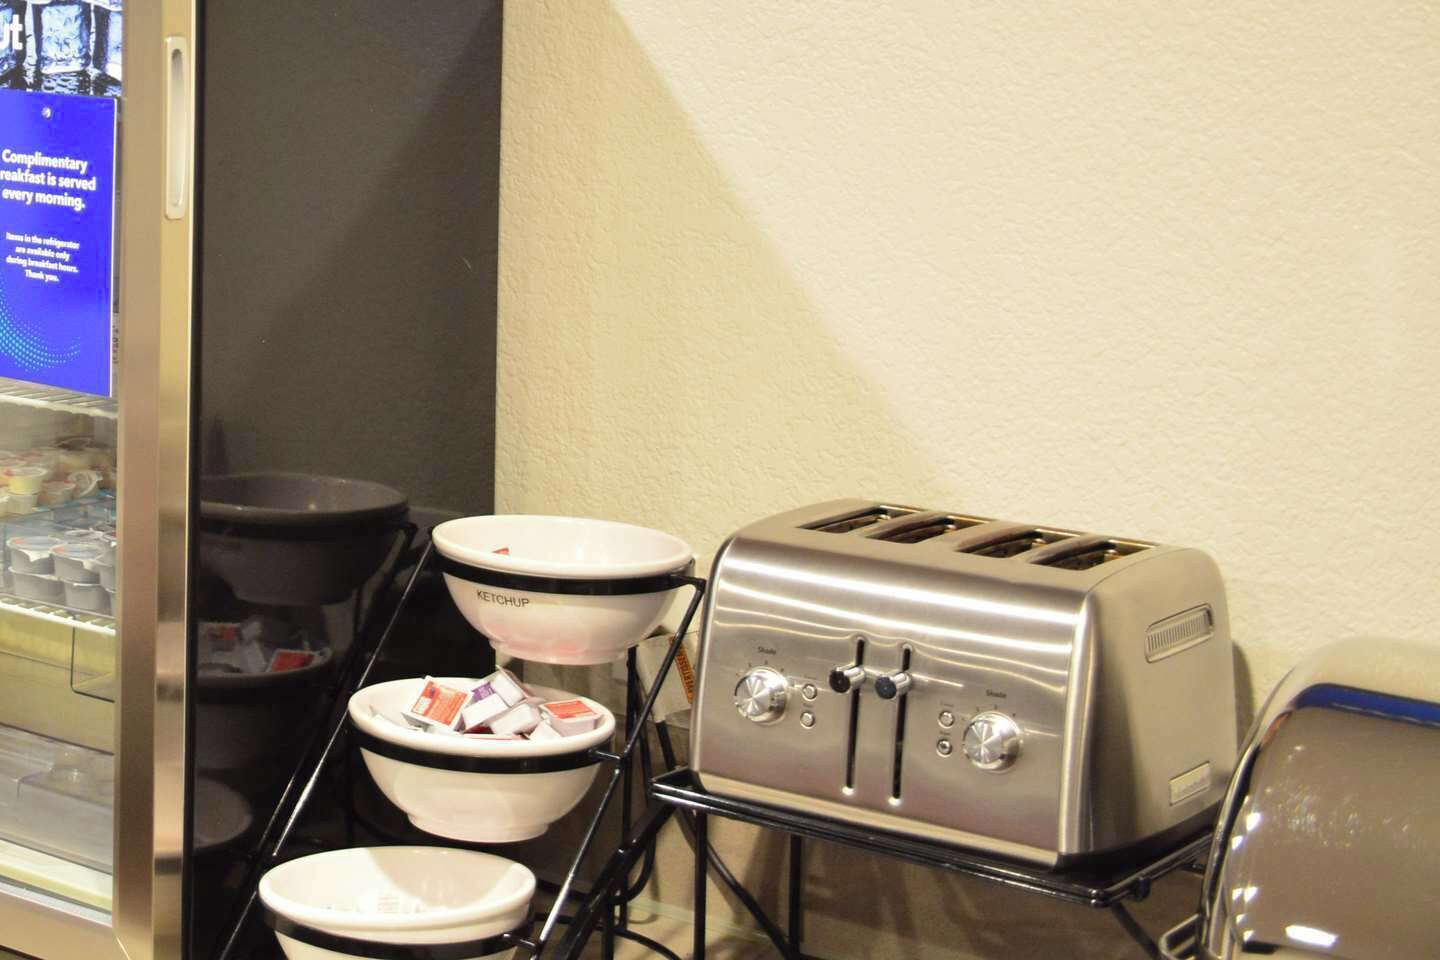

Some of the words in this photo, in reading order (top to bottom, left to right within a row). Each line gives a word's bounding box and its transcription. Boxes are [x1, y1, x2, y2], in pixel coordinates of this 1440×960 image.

[1, 149, 88, 174] Complimentary
[46, 171, 57, 187] is
[57, 176, 97, 191] served
[1, 188, 33, 205] every
[34, 191, 86, 212] morning.
[24, 233, 31, 243] in
[31, 234, 42, 244] the
[43, 236, 80, 250] refrigerator
[6, 254, 28, 268] during
[28, 257, 58, 270] breakfast
[58, 262, 79, 273] hours.
[27, 247, 55, 258] available
[55, 251, 70, 262] only
[25, 268, 45, 280] Thank
[45, 273, 60, 283] you.
[476, 588, 530, 608] KETCHUP
